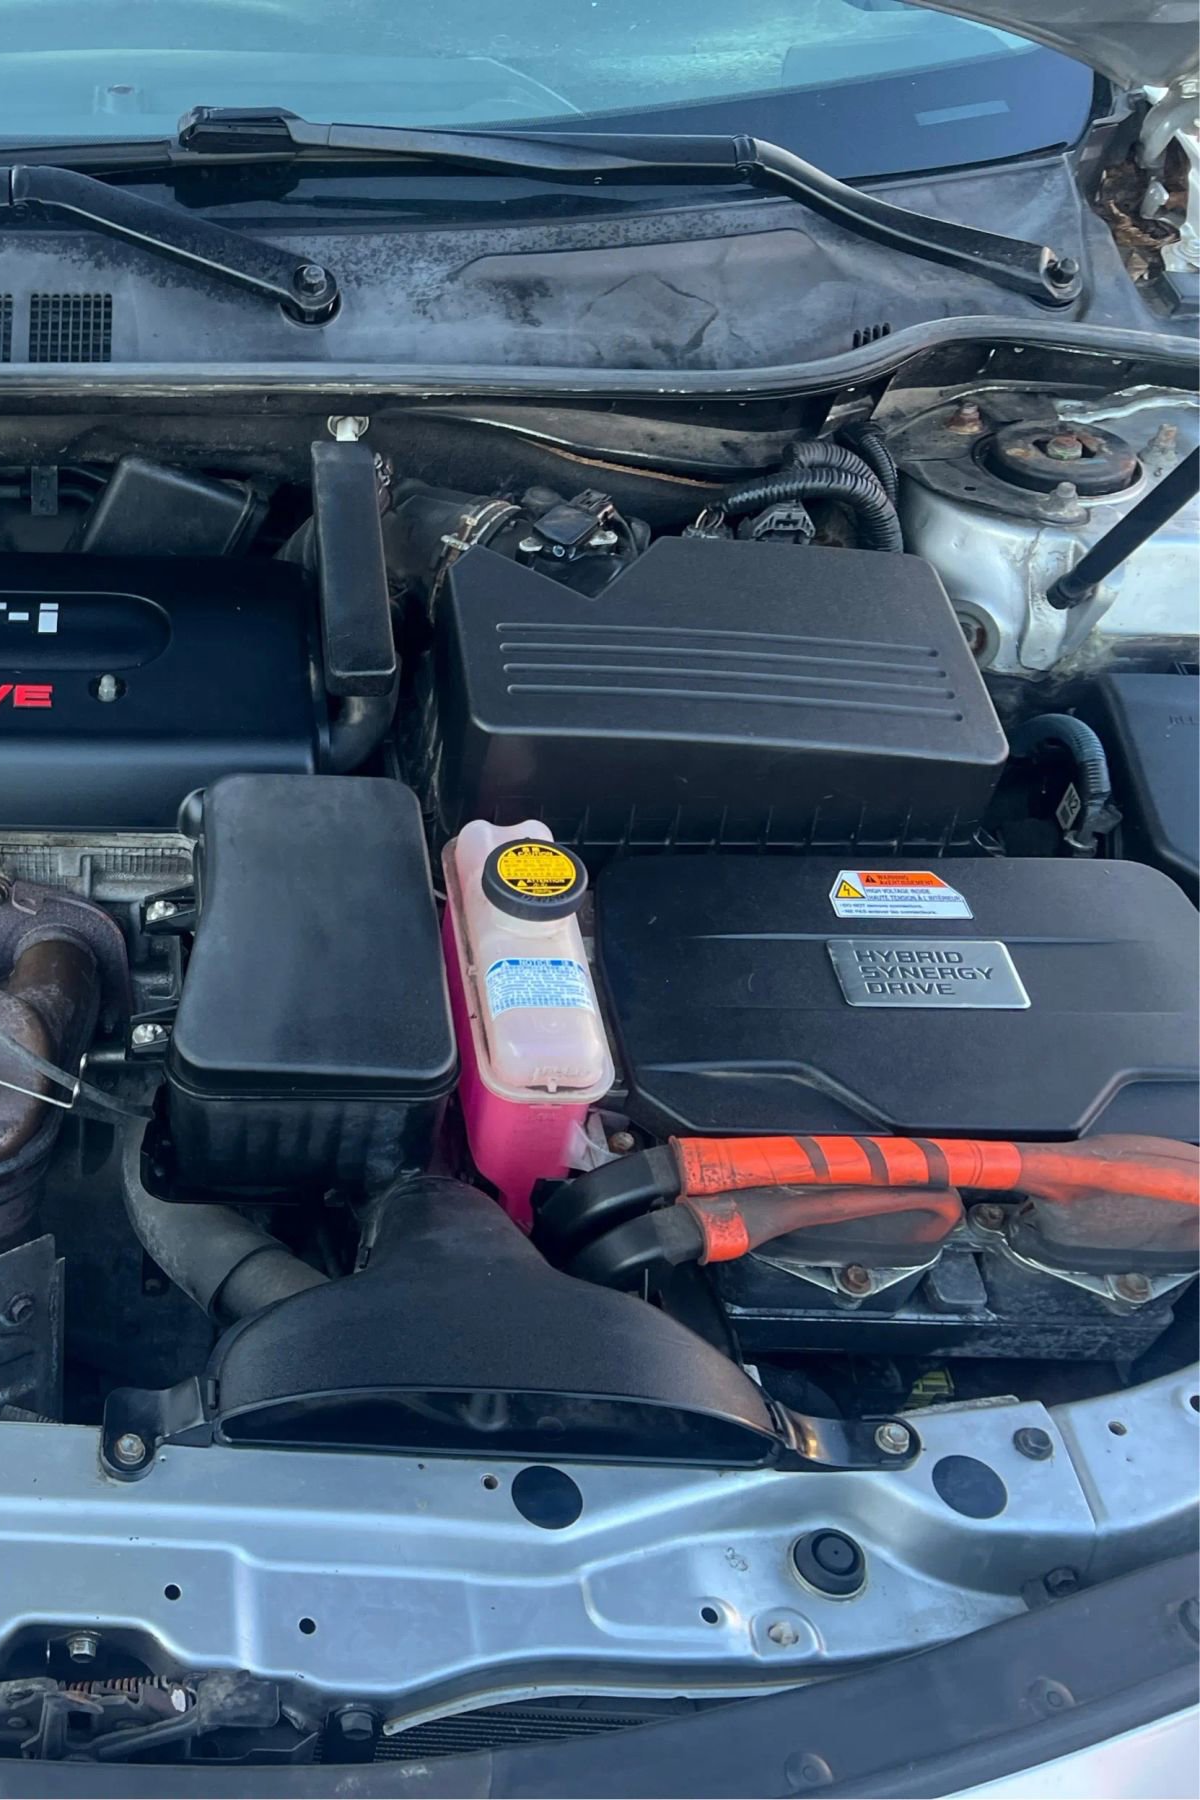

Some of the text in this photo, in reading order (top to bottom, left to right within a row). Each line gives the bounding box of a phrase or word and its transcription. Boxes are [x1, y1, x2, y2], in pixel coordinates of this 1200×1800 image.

[853, 949, 964, 964] HYBRID
[858, 966, 994, 981] SYNERGY
[864, 981, 956, 996] DRIVE
